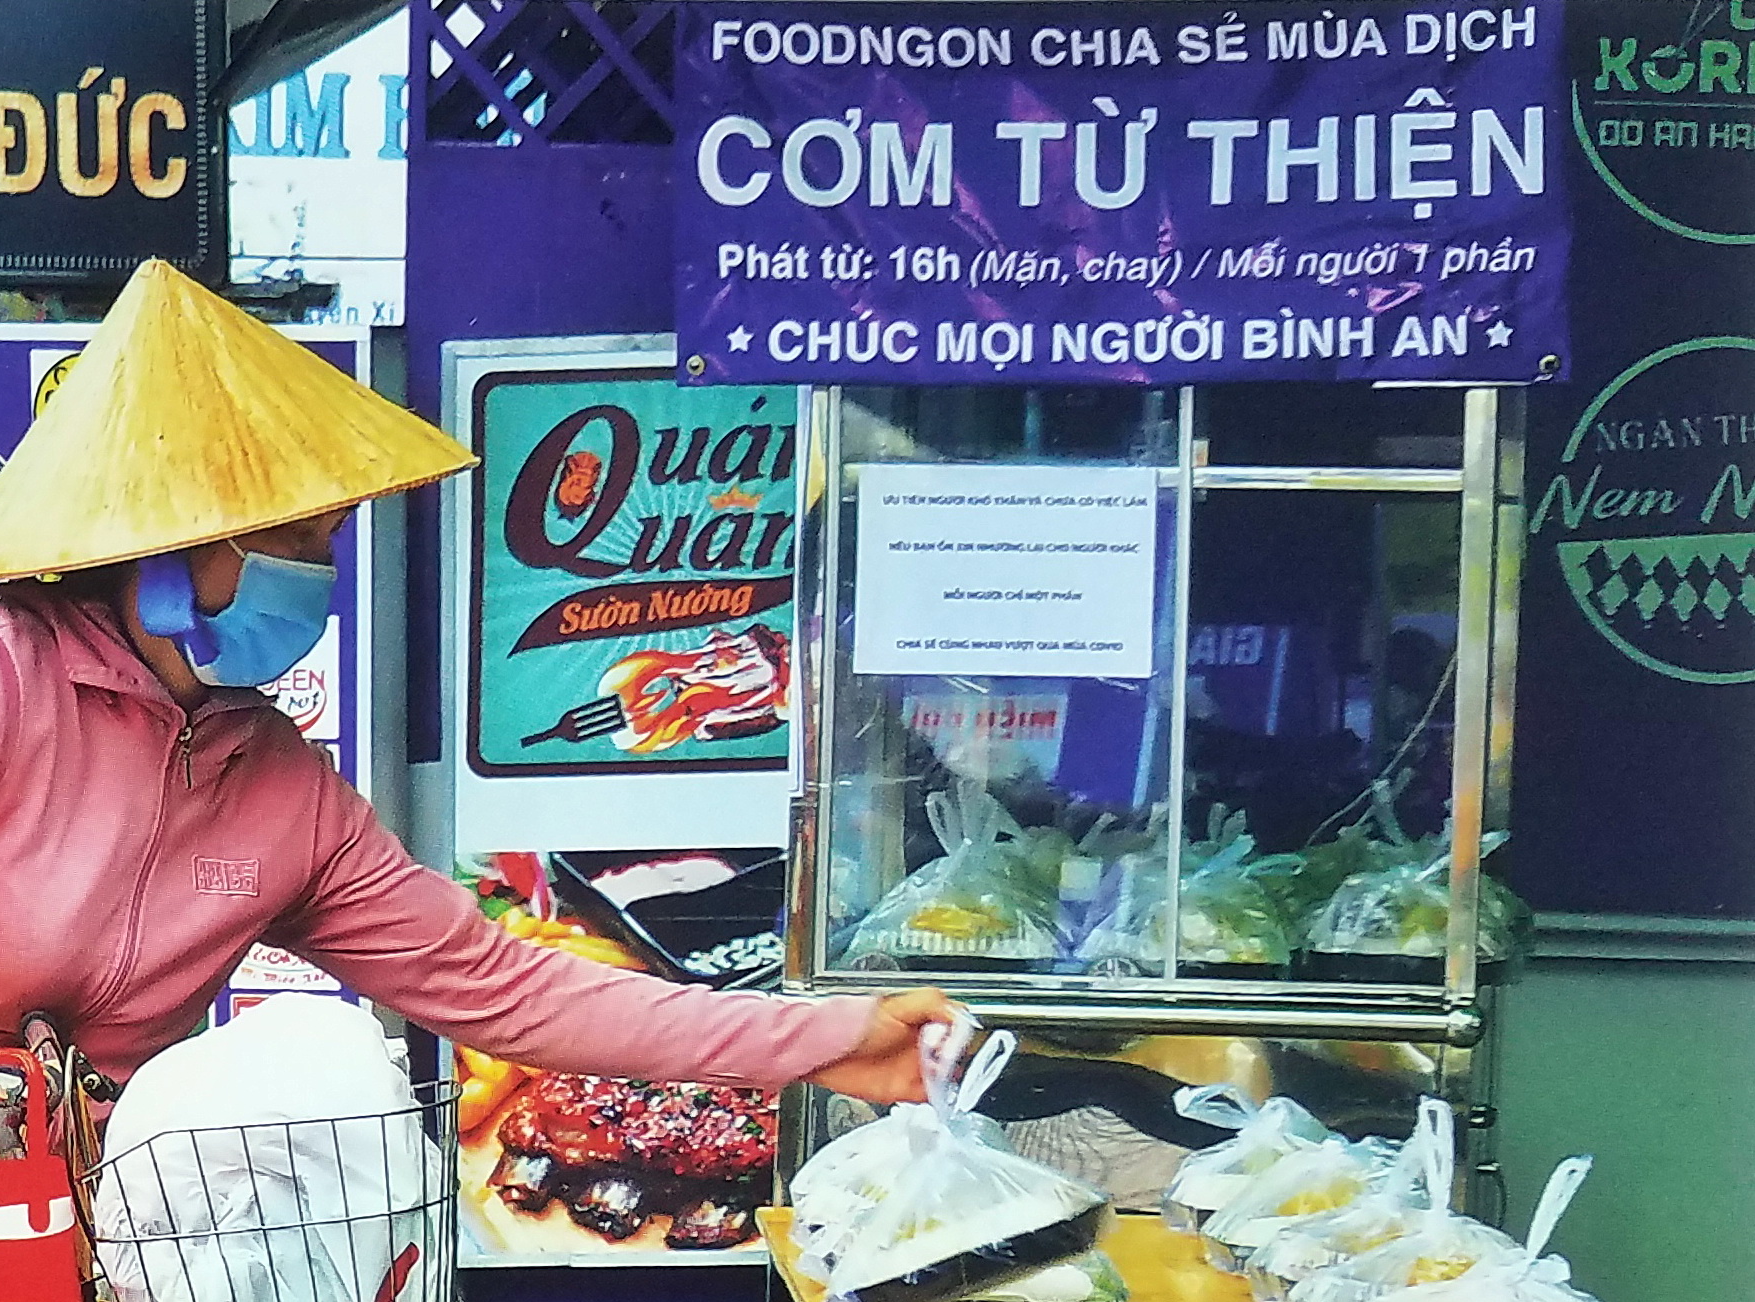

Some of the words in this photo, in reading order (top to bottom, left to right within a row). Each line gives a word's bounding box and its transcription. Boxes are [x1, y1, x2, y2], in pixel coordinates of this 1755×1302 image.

[711, 20, 1012, 68] FOODNGON
[1031, 27, 1162, 67] CHIA
[1267, 10, 1388, 62] MÙA
[1405, 5, 1536, 62] DỊCH
[1594, 37, 1755, 94] KOR
[697, 106, 954, 207] CƠM
[995, 96, 1159, 210] TỪ
[1186, 87, 1545, 220] THIỆN
[718, 243, 810, 282] Phát
[820, 242, 874, 281] từ:
[889, 246, 961, 282] 16h
[969, 250, 1070, 288] (Mặn,
[1083, 250, 1185, 288] chay)
[1216, 236, 1286, 279] Mỗi
[1294, 242, 1401, 286] người
[1438, 236, 1538, 281] phần
[767, 309, 920, 364] CHÚC
[935, 321, 1035, 373] MỌI
[1050, 307, 1225, 364] NGƯỜI
[1242, 305, 1375, 360] BÌNH
[1390, 312, 1469, 358] AN
[1529, 463, 1685, 535] Nem
[559, 594, 641, 635] Sườn
[645, 582, 756, 624] Nướng
